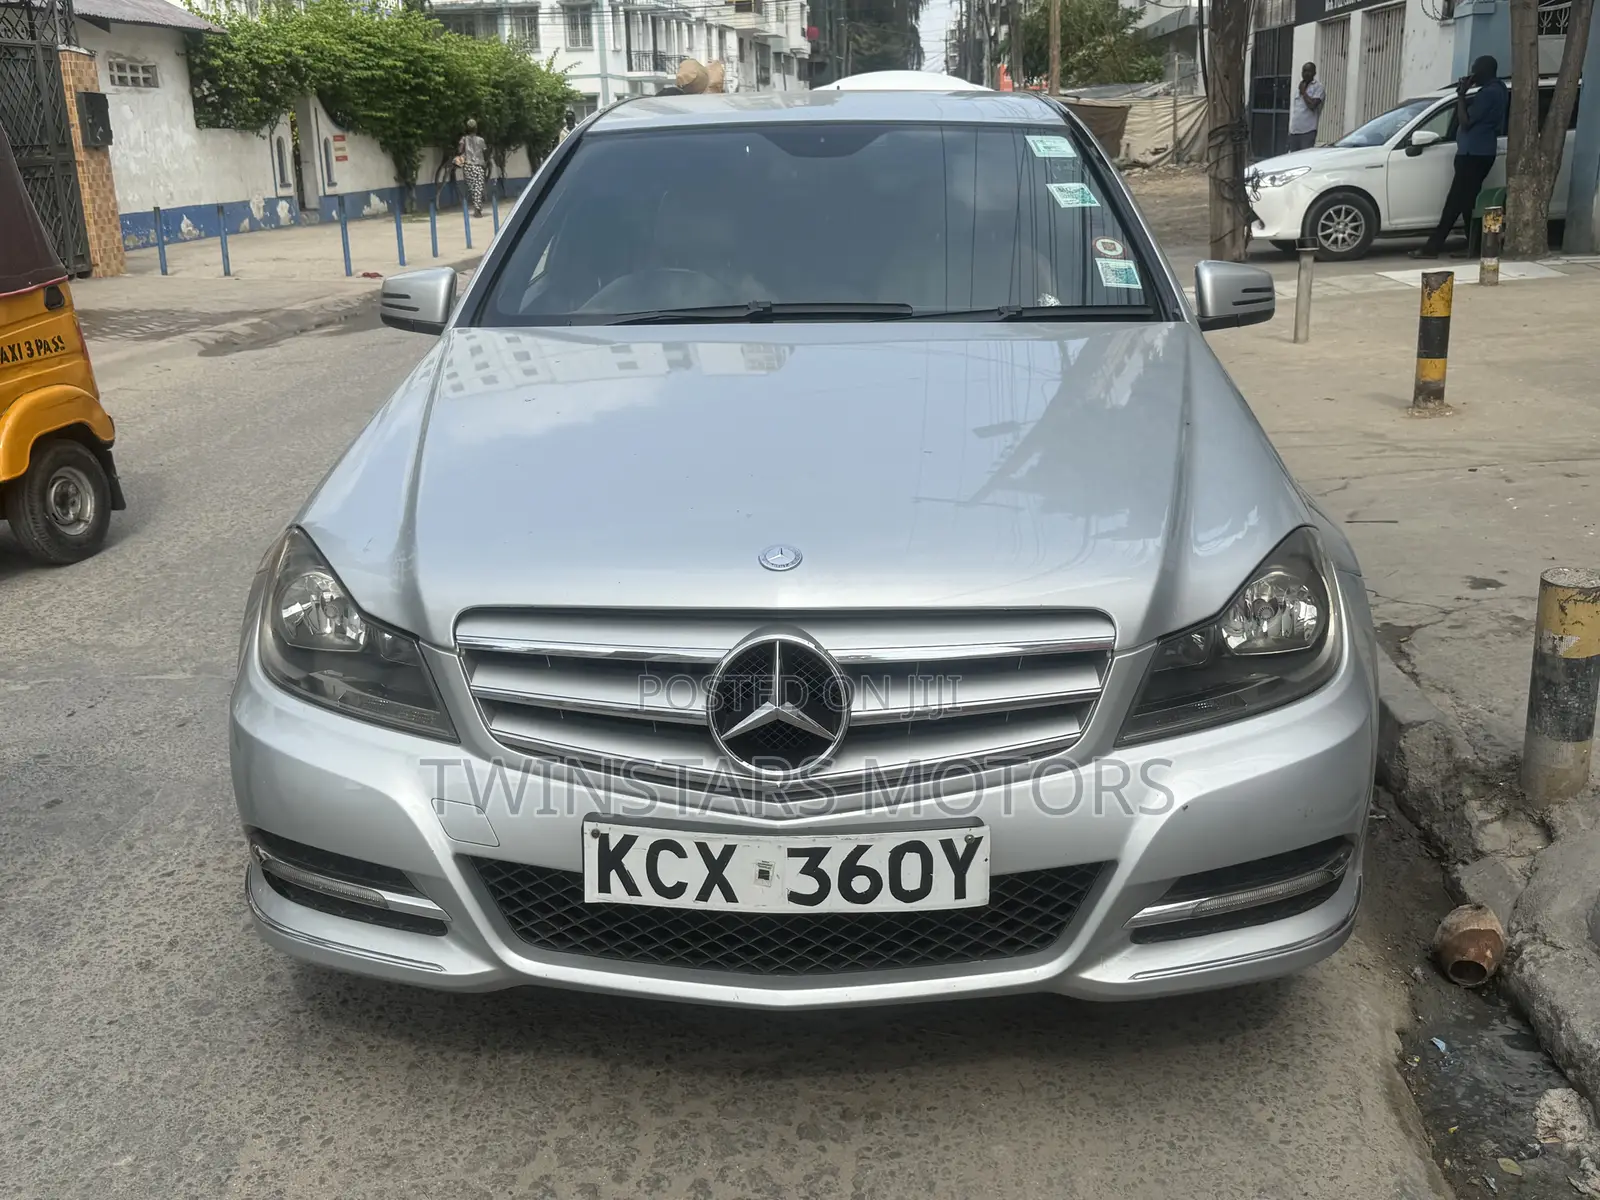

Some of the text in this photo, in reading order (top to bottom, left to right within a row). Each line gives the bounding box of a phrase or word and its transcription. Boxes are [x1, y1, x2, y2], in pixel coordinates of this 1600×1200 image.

[24, 340, 34, 358] 3
[597, 833, 984, 907] KCX 360Y
